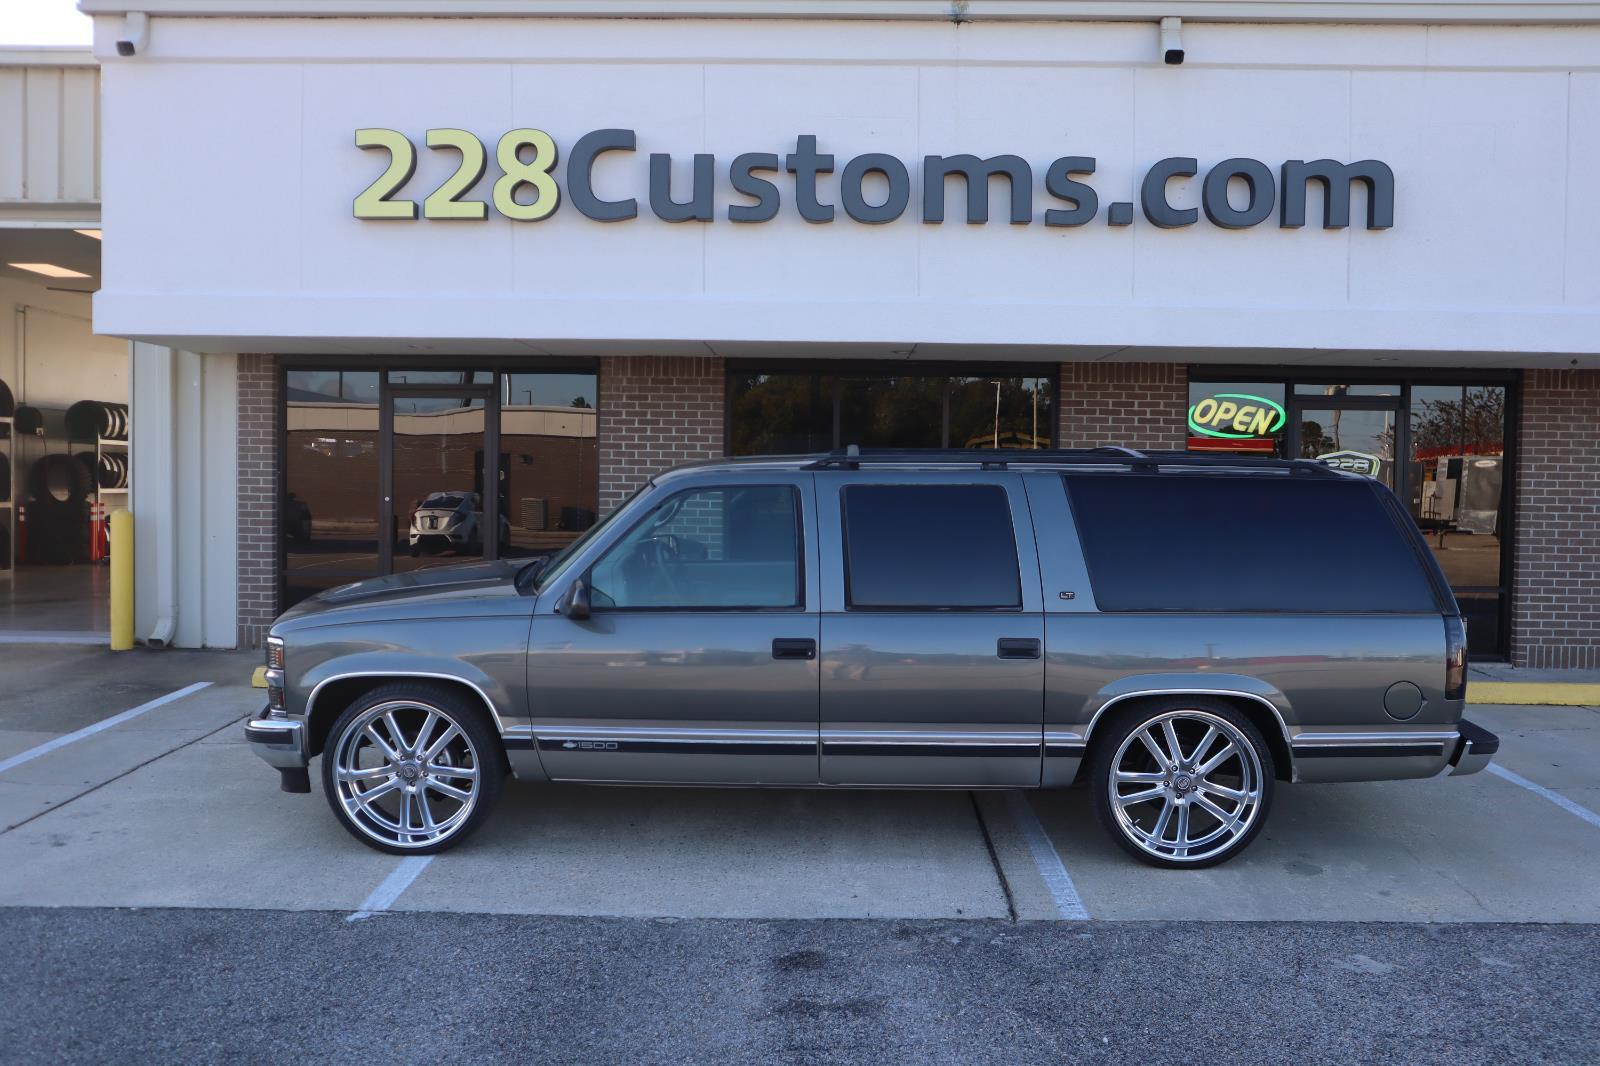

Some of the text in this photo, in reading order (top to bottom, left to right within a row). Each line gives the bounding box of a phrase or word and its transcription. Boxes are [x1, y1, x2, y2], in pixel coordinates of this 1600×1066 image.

[352, 127, 1395, 230] 228Customs.com
[1193, 398, 1276, 435] OPEN
[577, 741, 618, 750] 1500
